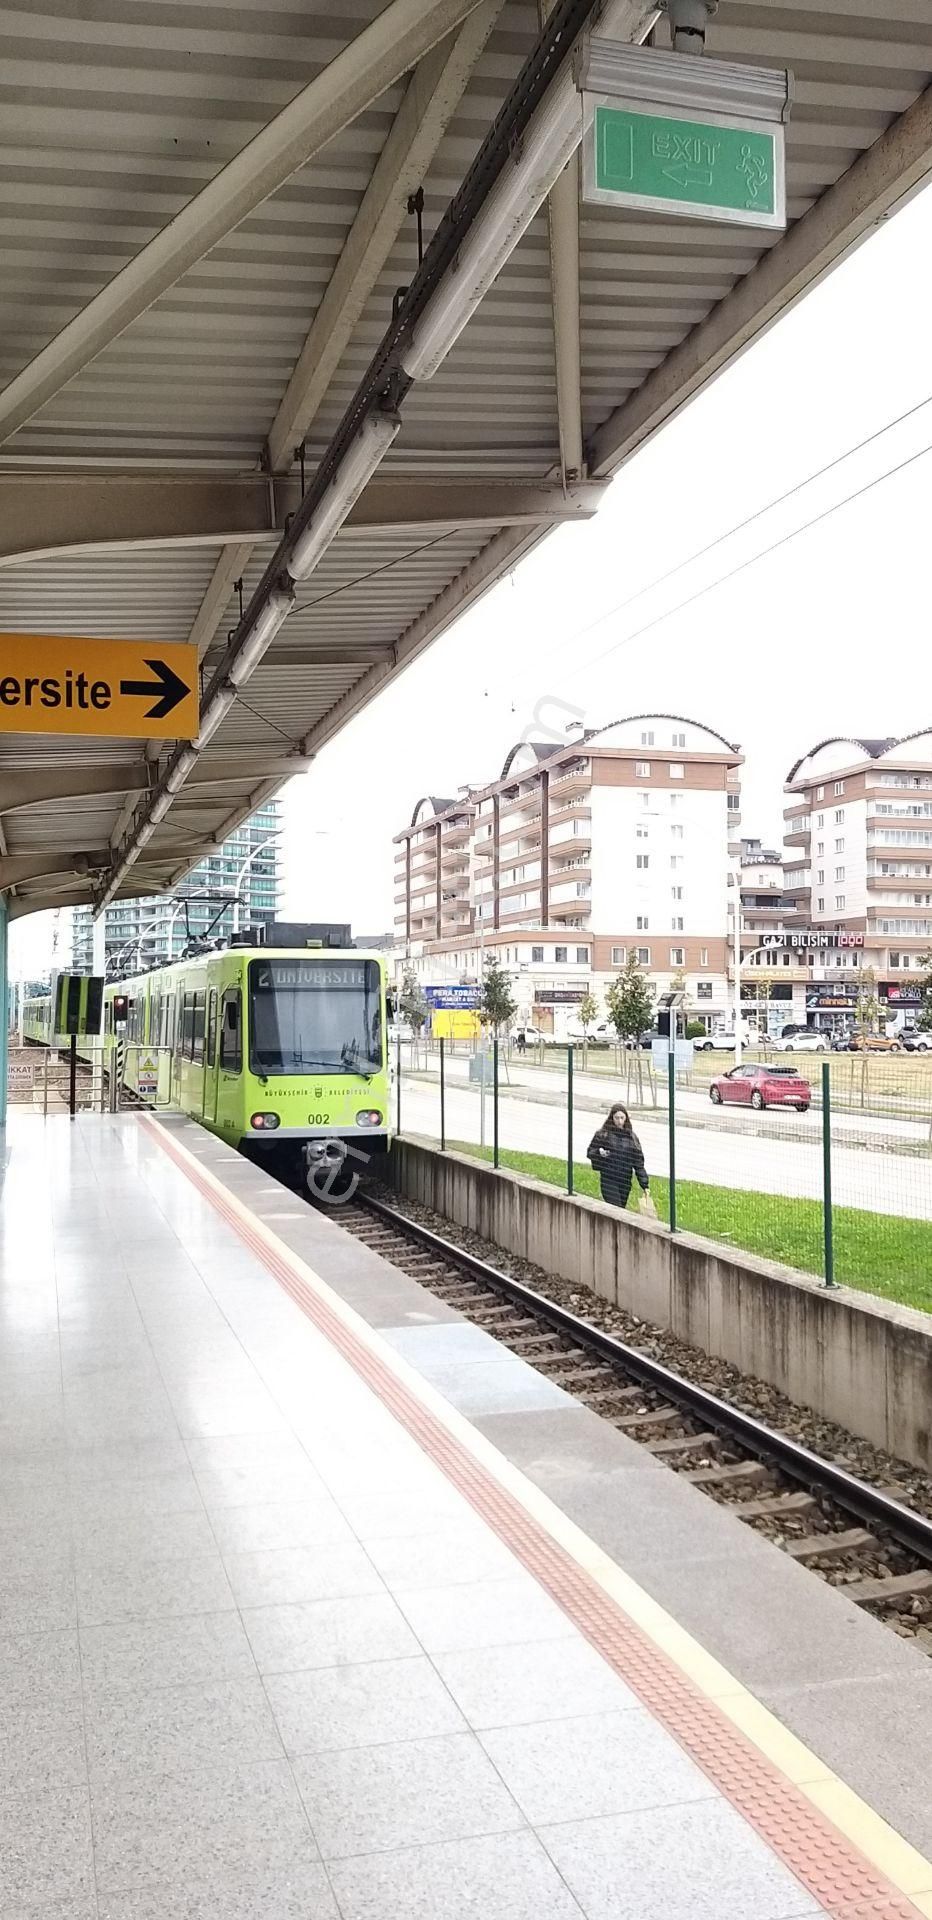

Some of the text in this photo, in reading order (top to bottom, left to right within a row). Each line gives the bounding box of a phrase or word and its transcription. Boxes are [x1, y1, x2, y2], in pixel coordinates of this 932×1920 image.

[652, 132, 721, 166] EXIT
[0, 670, 112, 709] ersite
[308, 1113, 330, 1125] 002
